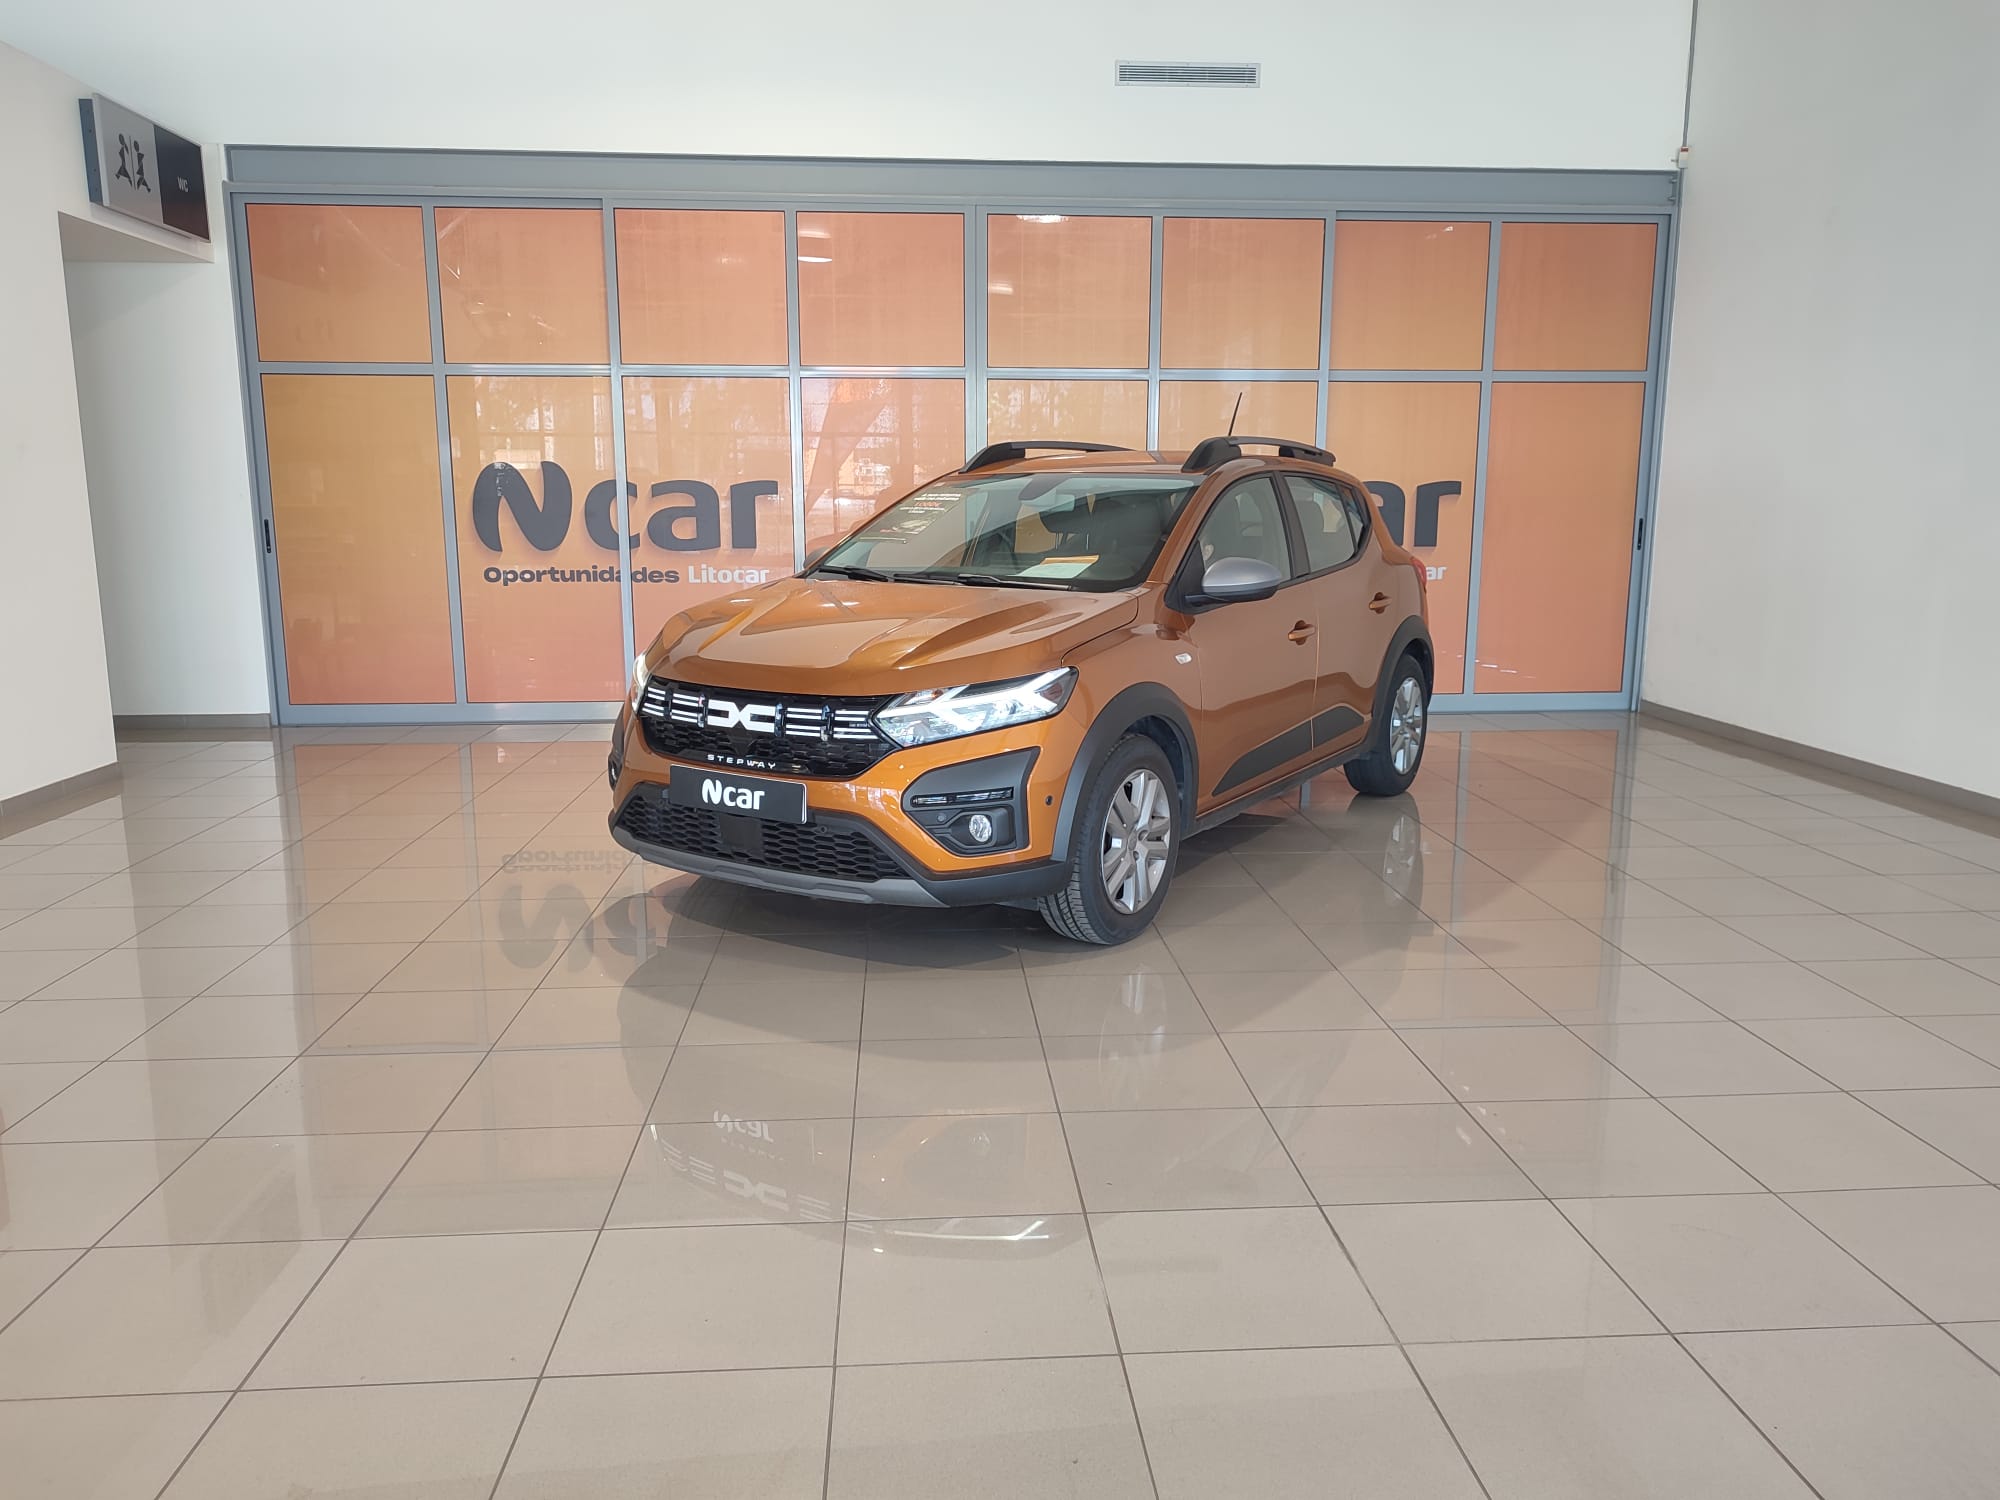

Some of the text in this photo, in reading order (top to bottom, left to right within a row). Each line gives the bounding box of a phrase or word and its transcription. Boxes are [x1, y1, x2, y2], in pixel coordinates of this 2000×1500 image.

[177, 175, 189, 193] WC
[472, 460, 779, 552] Ncar
[687, 563, 770, 584] Litocar
[707, 754, 776, 769] STEPWAY
[701, 778, 766, 811] Ncar
